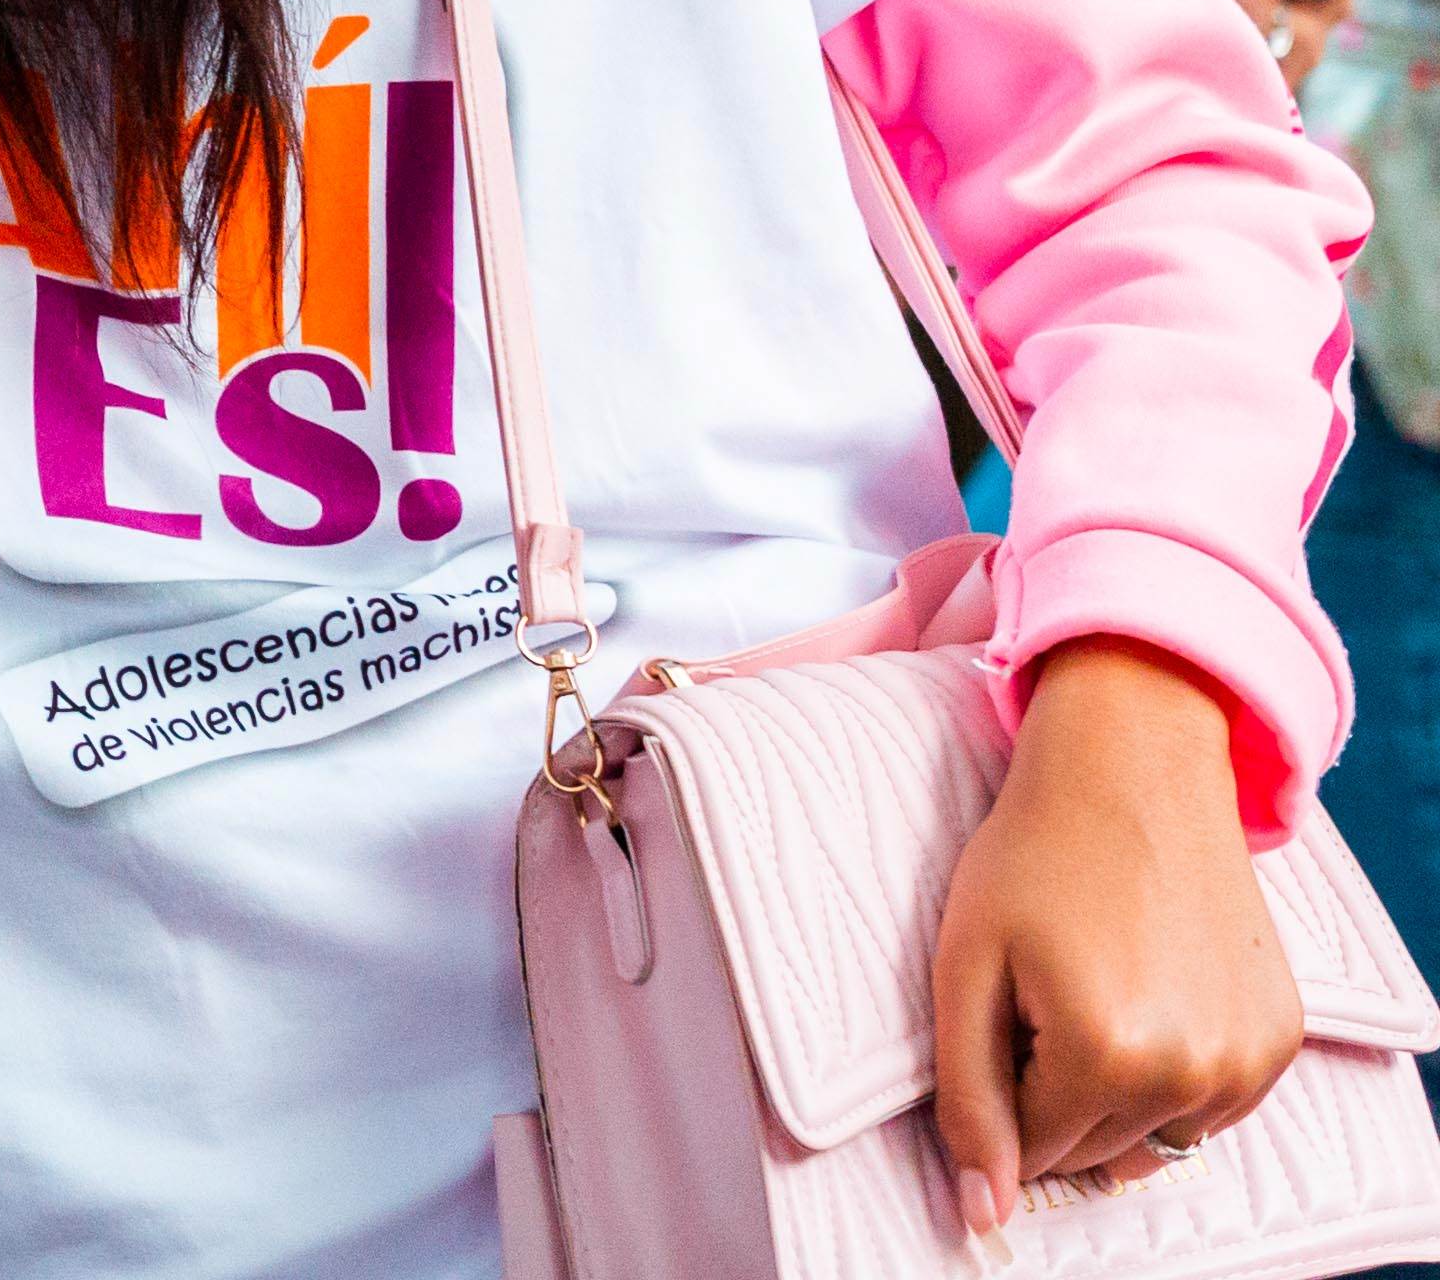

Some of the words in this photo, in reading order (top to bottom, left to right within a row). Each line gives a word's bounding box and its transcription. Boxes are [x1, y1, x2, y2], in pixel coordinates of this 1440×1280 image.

[33, 80, 463, 547] Es!
[45, 593, 419, 722] Adolescencias
[72, 733, 126, 773] de
[128, 669, 345, 752] violencias
